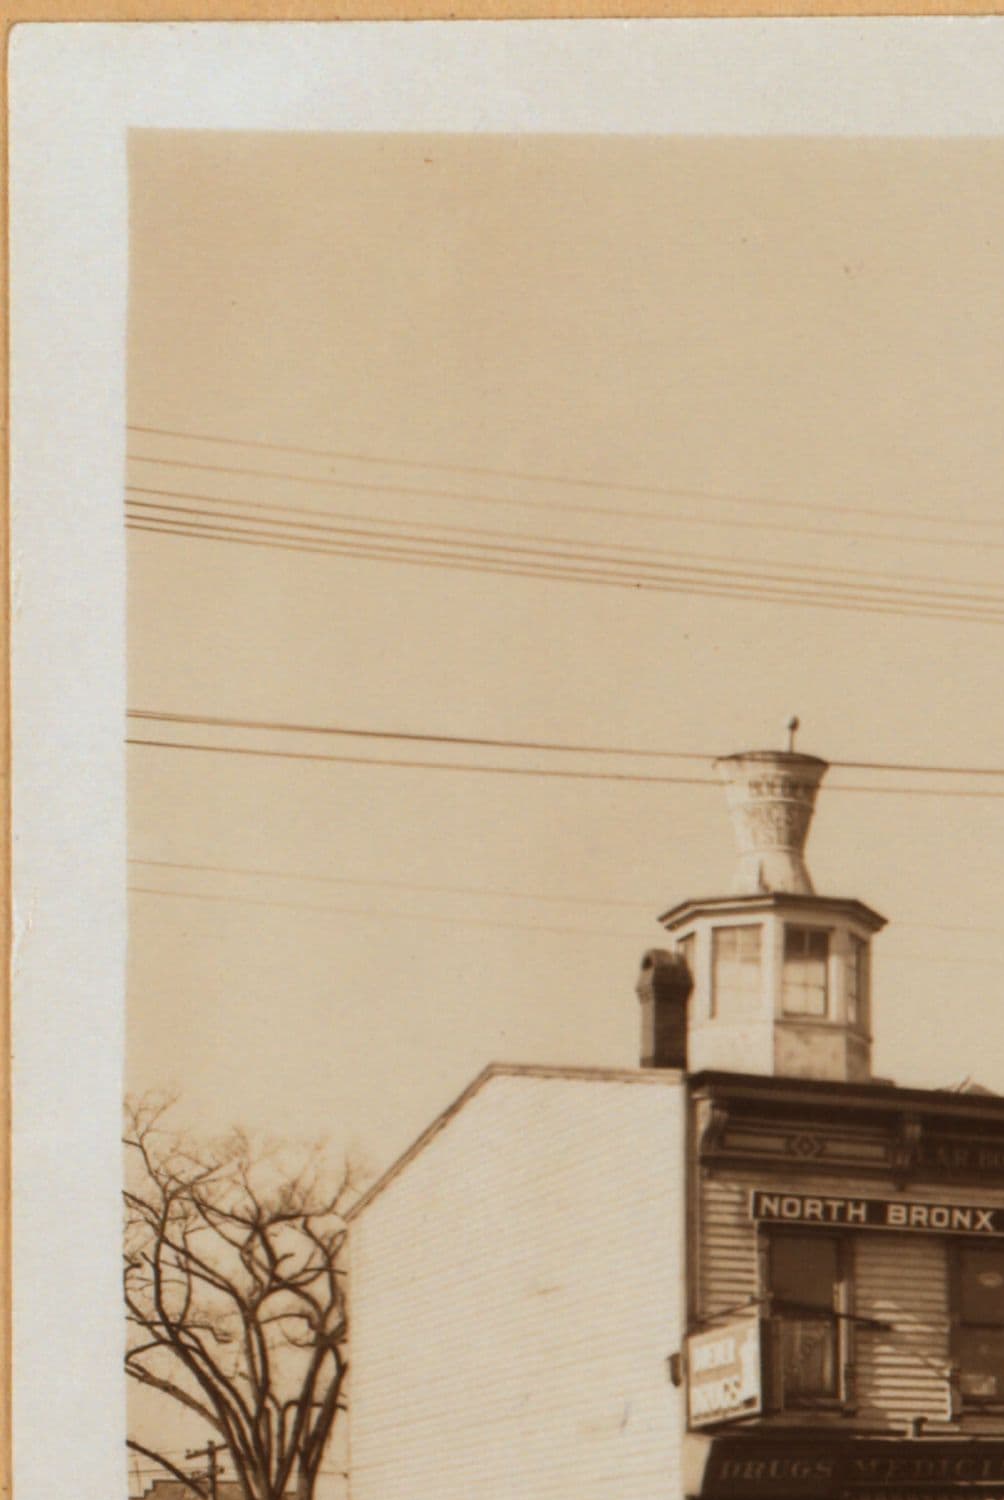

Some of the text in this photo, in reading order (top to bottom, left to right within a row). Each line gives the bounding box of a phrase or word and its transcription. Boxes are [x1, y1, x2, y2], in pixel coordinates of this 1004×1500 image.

[760, 1195, 867, 1223] NORTH
[886, 1203, 994, 1232] BRONX
[719, 1458, 833, 1480] DRUGS
